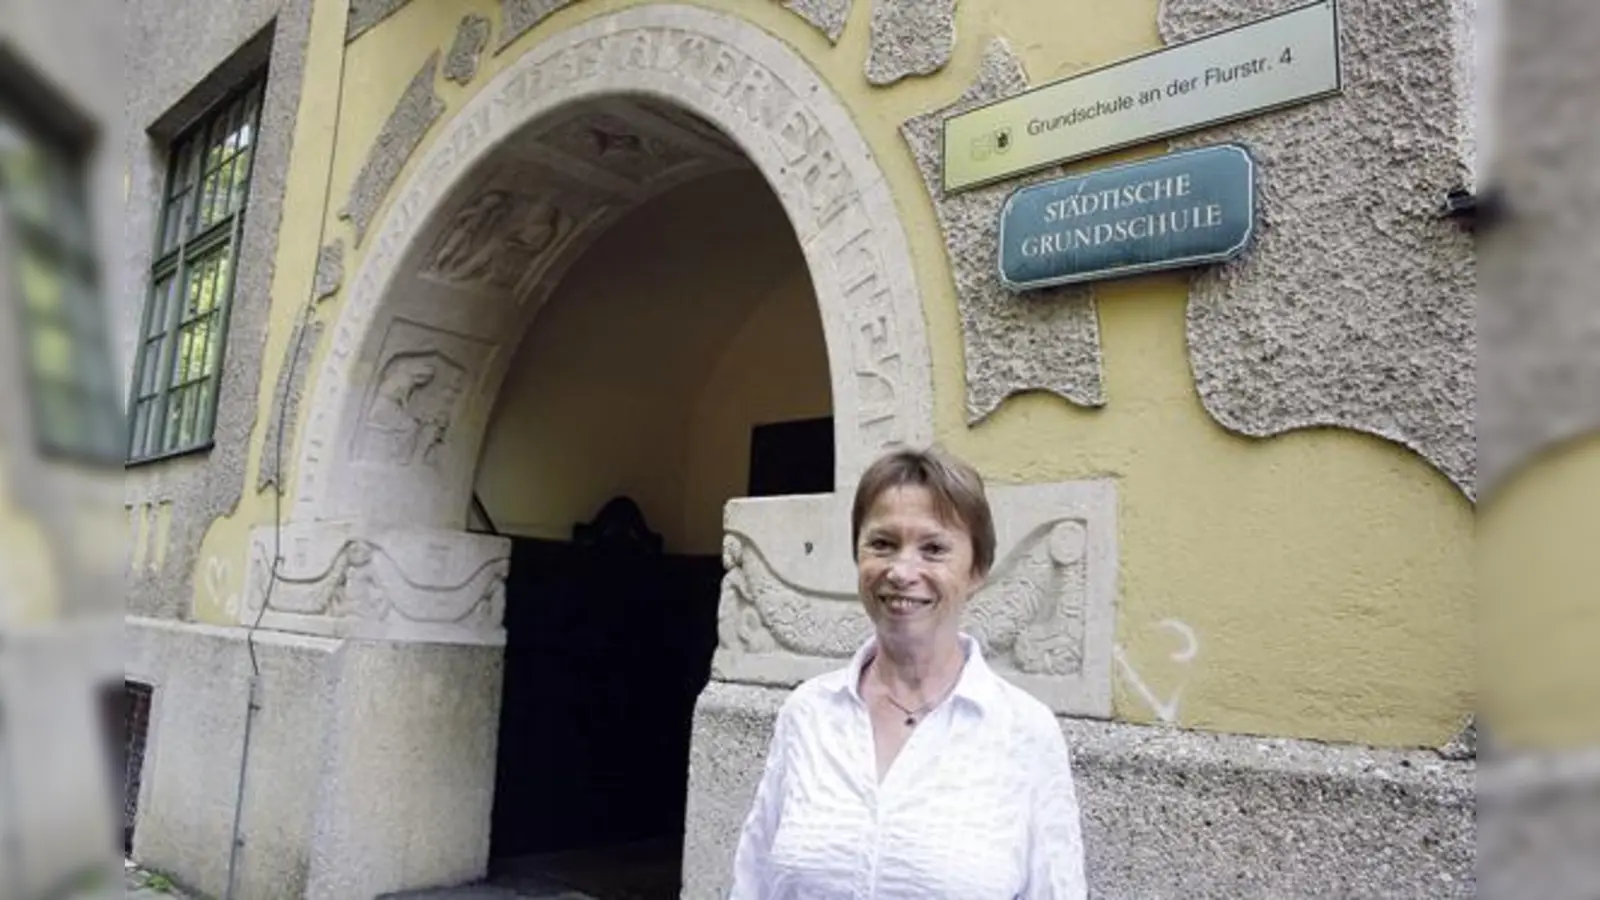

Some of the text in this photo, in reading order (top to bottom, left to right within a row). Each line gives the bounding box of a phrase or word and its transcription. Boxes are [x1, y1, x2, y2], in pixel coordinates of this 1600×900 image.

[1026, 47, 1293, 136] Grundschule an der Flurstr. 4
[1043, 173, 1191, 223] STÄDTISCHE
[1021, 204, 1222, 257] GRUNDSCHULE
